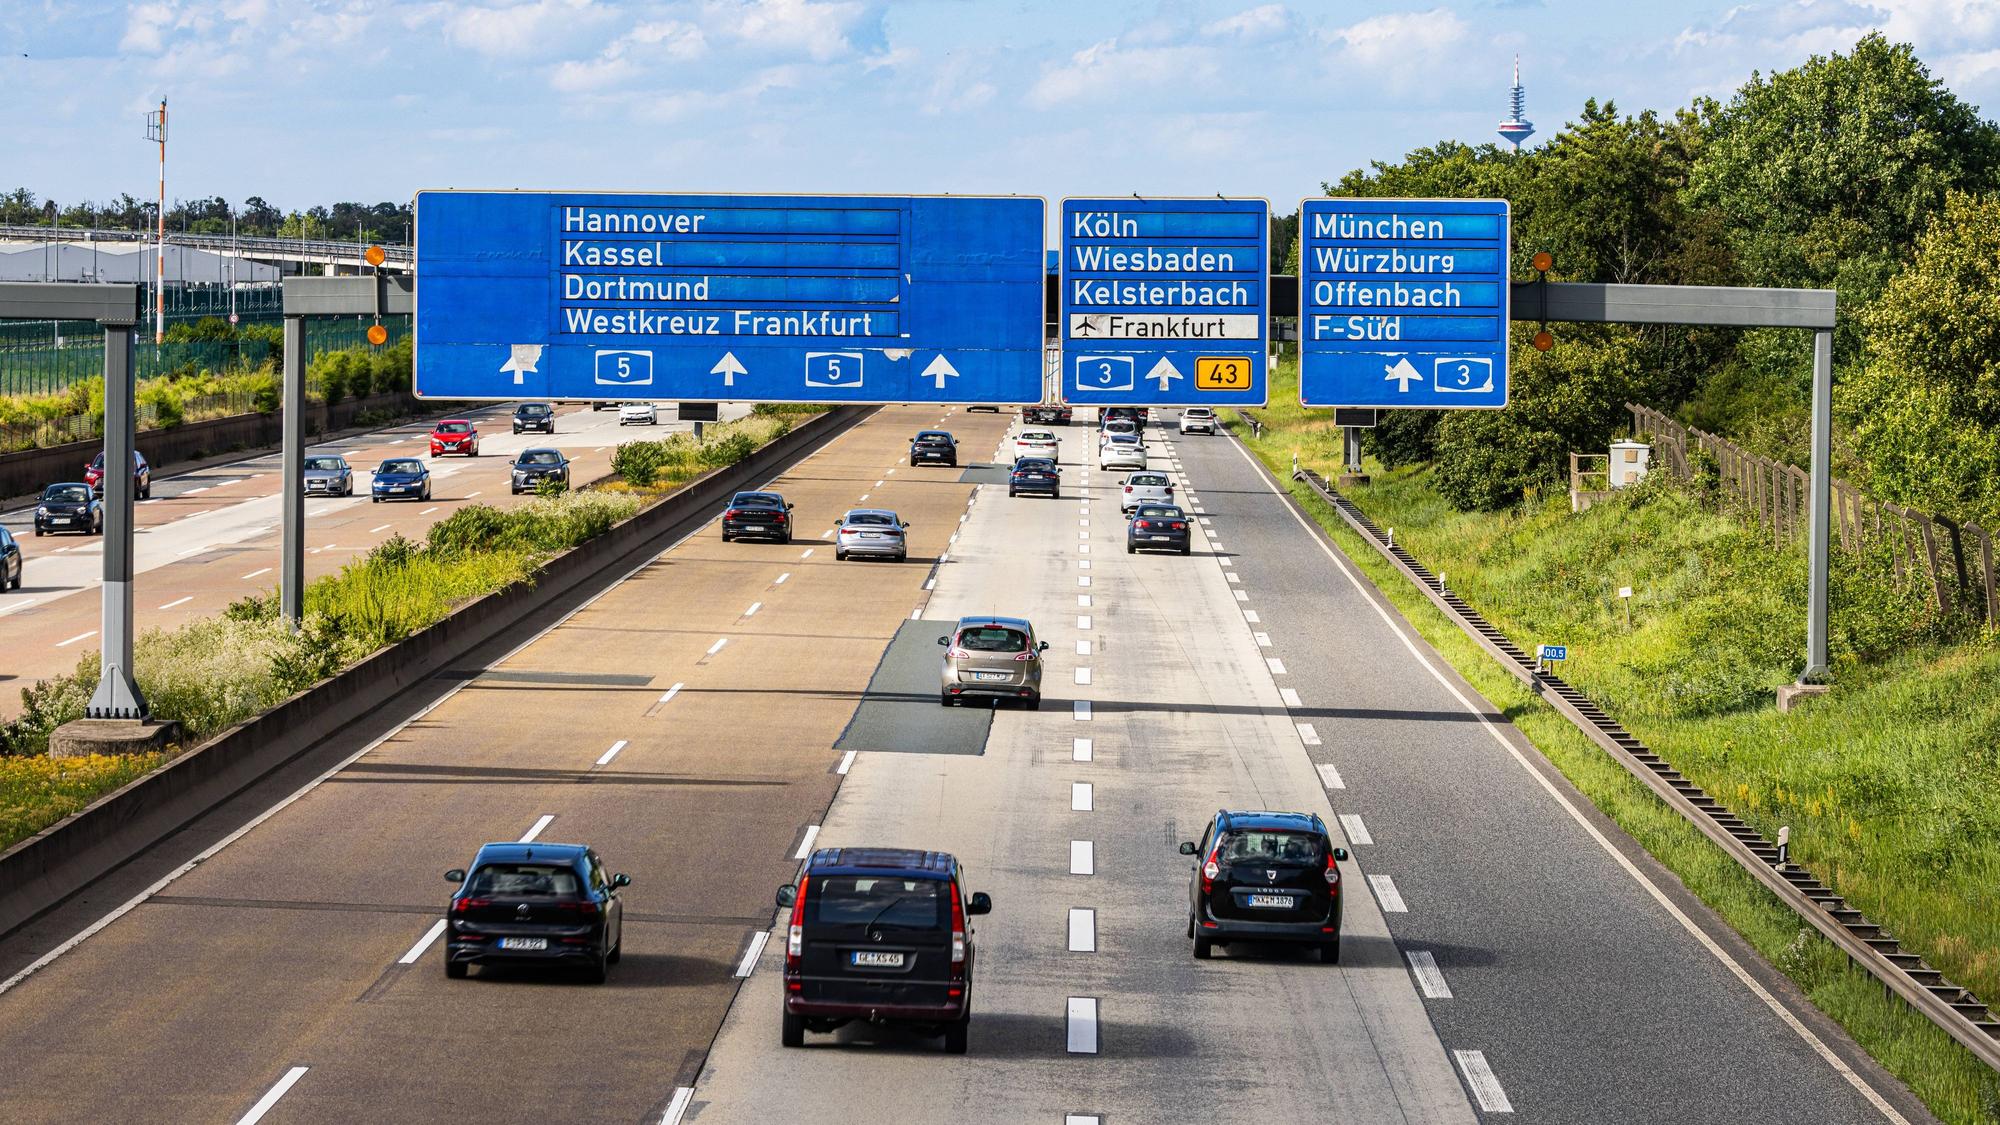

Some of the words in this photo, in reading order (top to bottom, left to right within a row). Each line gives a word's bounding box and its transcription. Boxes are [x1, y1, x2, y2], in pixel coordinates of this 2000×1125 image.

[566, 207, 706, 233] Hannover
[1074, 212, 1138, 238] Köln
[1315, 213, 1444, 239] München
[565, 241, 663, 266] Kassel
[1075, 246, 1233, 272] Wiesbaden
[1315, 247, 1454, 274] Würzburg
[565, 275, 709, 301] Dortmund
[1074, 280, 1247, 306] Kelsterbach
[1315, 281, 1461, 307] Offenbach
[566, 309, 720, 335] Westkreuz
[734, 310, 872, 336] Frankfurt
[1109, 316, 1226, 338] Frankfurt
[1314, 315, 1401, 341] F-Süd
[618, 357, 630, 378] 5
[828, 359, 841, 380] 5
[1099, 363, 1112, 384] 3
[1209, 363, 1238, 384] 43
[1457, 364, 1470, 386] 3
